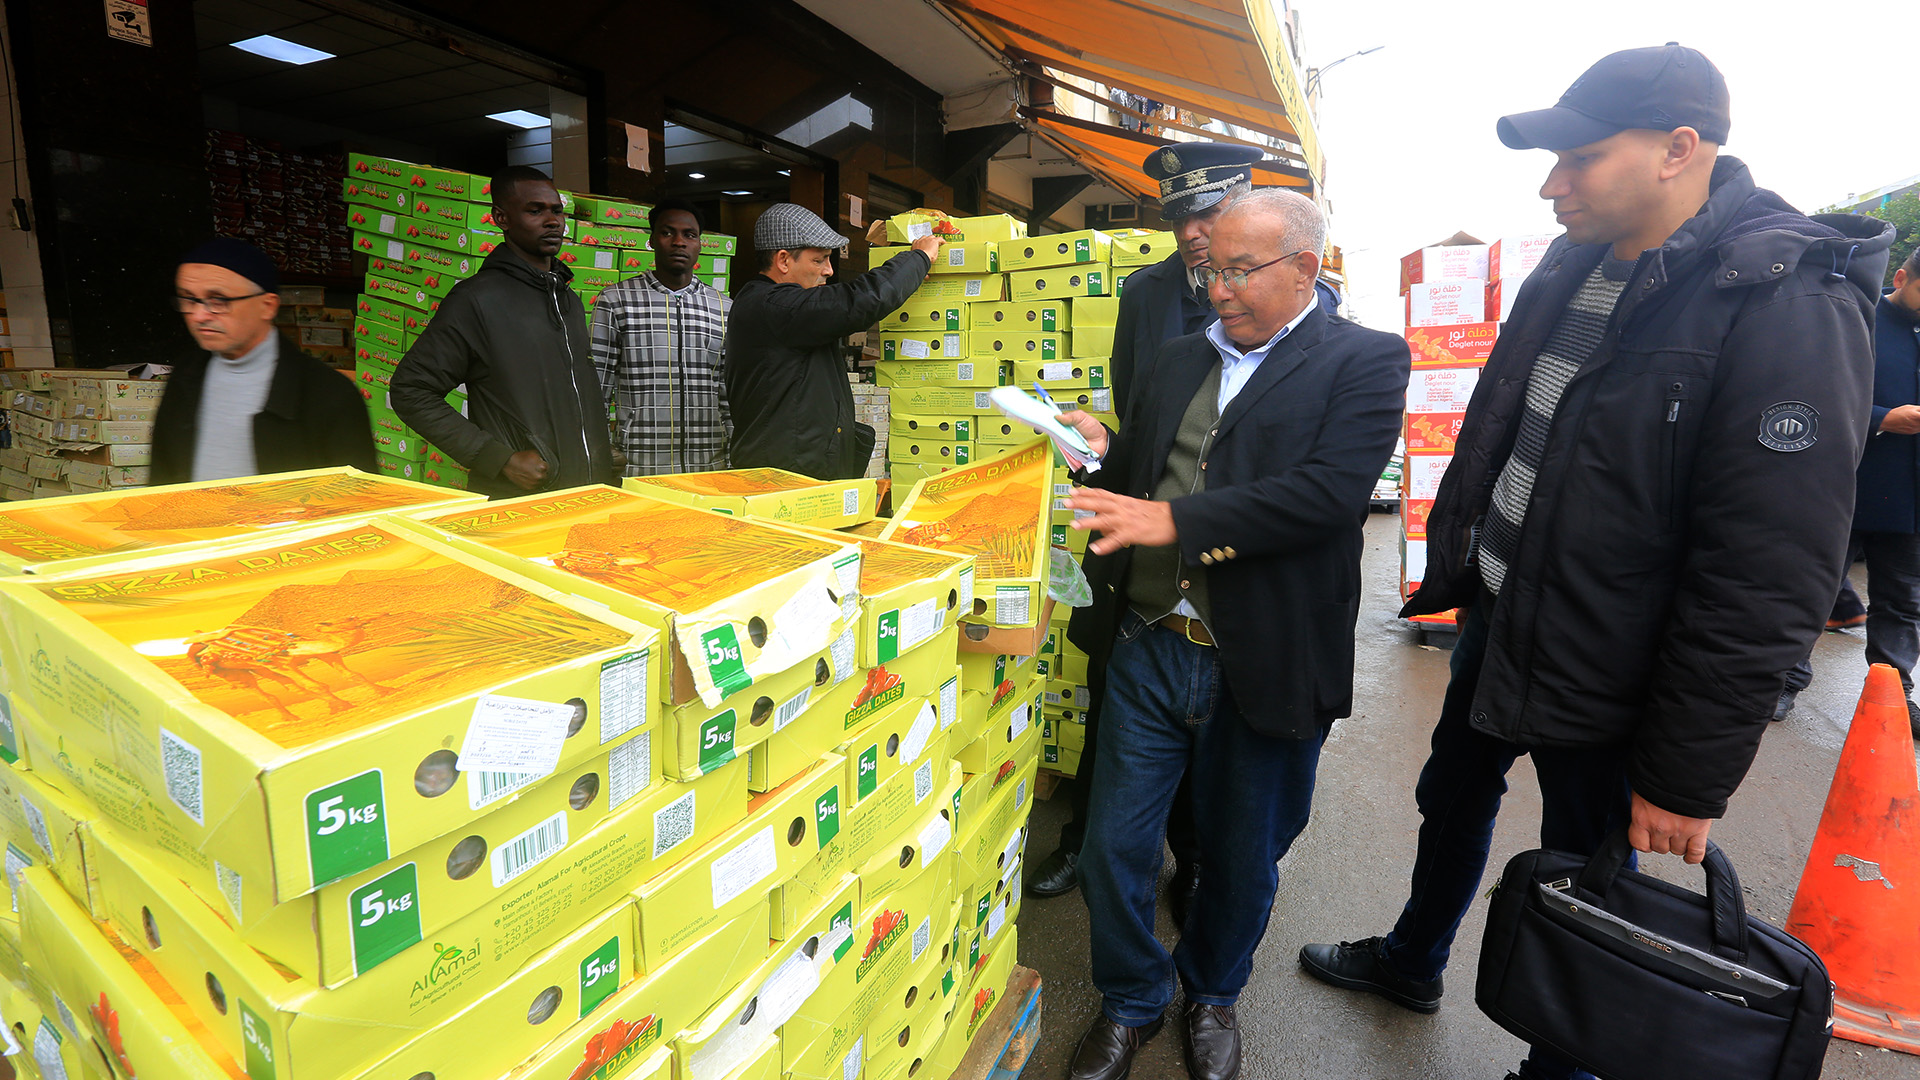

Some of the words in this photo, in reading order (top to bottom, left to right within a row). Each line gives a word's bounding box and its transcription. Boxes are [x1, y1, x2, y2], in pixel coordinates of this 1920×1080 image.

[1448, 328, 1465, 341] نور
[1449, 341, 1474, 349] Deglet
[1474, 339, 1493, 347] nour
[1467, 327, 1494, 338] دقلة
[1767, 404, 1792, 415] DESIGN
[1794, 404, 1815, 416] STYLE
[1764, 438, 1809, 449] STYLISH
[926, 472, 978, 492] GIZZA
[986, 446, 1044, 477] DATES
[530, 491, 620, 514] DATES
[52, 566, 228, 597] GIZZA
[237, 533, 385, 570] DATES
[155, 574, 228, 591] PREMIUM
[233, 561, 299, 577] SELECTED
[302, 550, 352, 564] GOLDEN
[357, 539, 391, 554] DATES
[880, 619, 897, 639] 5kg
[707, 637, 739, 666] 5kg
[846, 701, 872, 724] GIZZA
[874, 685, 902, 708] DATES
[704, 725, 732, 750] 5kg
[860, 756, 876, 776] 5kg
[316, 795, 378, 836] 5kg
[818, 799, 837, 822] 5kg
[537, 873, 559, 890] Alamal
[560, 866, 571, 877] For
[573, 844, 608, 869] Agricultural
[609, 833, 627, 847] Crops
[360, 889, 413, 928] 5kg
[502, 911, 516, 921] Main
[504, 924, 521, 939] +20
[504, 932, 521, 947] +20
[1632, 932, 1672, 954] Classic
[583, 958, 617, 988] 5kg
[858, 947, 881, 976] GIZZA
[243, 1010, 272, 1063] 5kg
